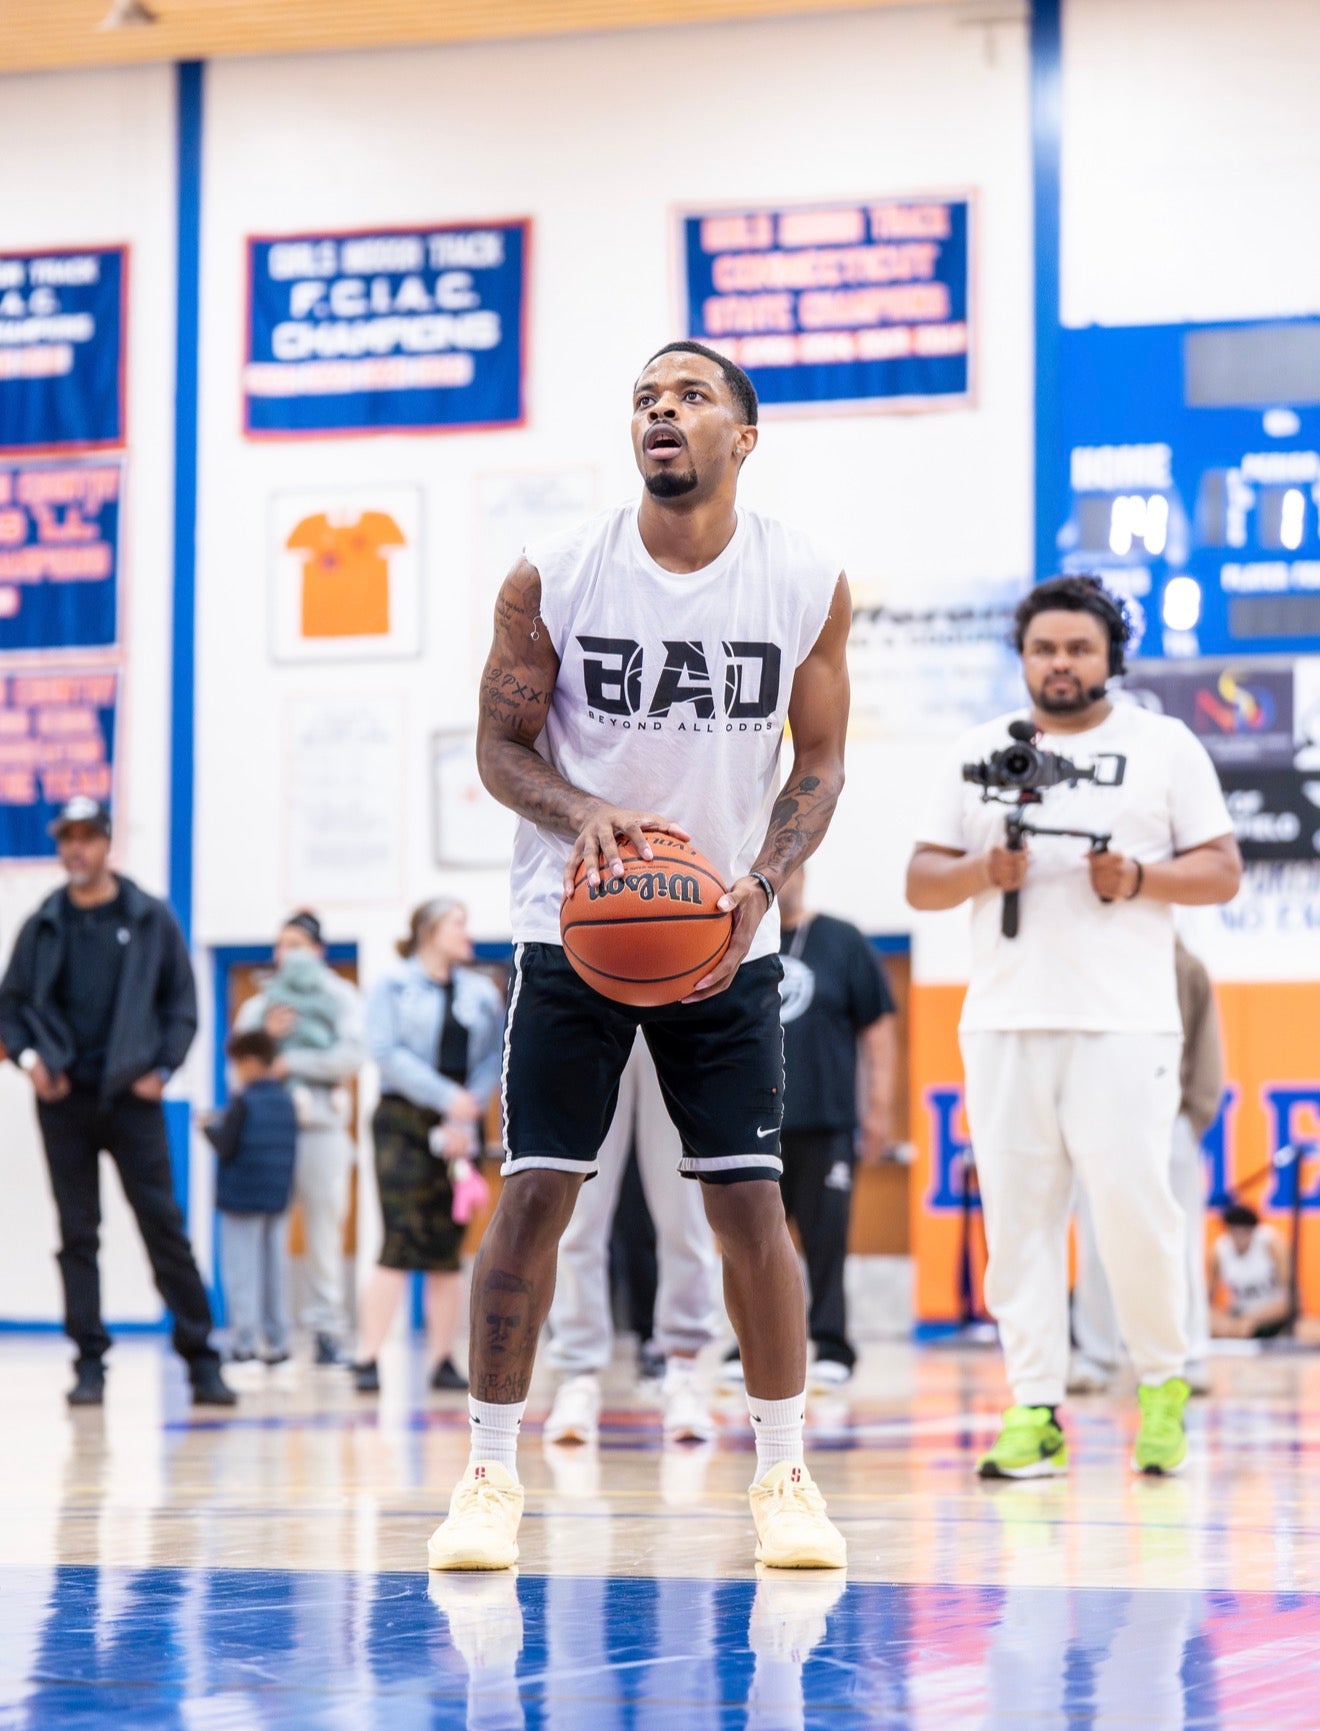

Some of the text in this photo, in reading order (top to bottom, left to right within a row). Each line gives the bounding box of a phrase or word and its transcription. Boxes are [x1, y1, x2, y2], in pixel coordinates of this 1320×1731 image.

[575, 635, 782, 720] BAD
[588, 710, 772, 733] BEYOND ALL ODDS
[588, 872, 702, 905] Wilson
